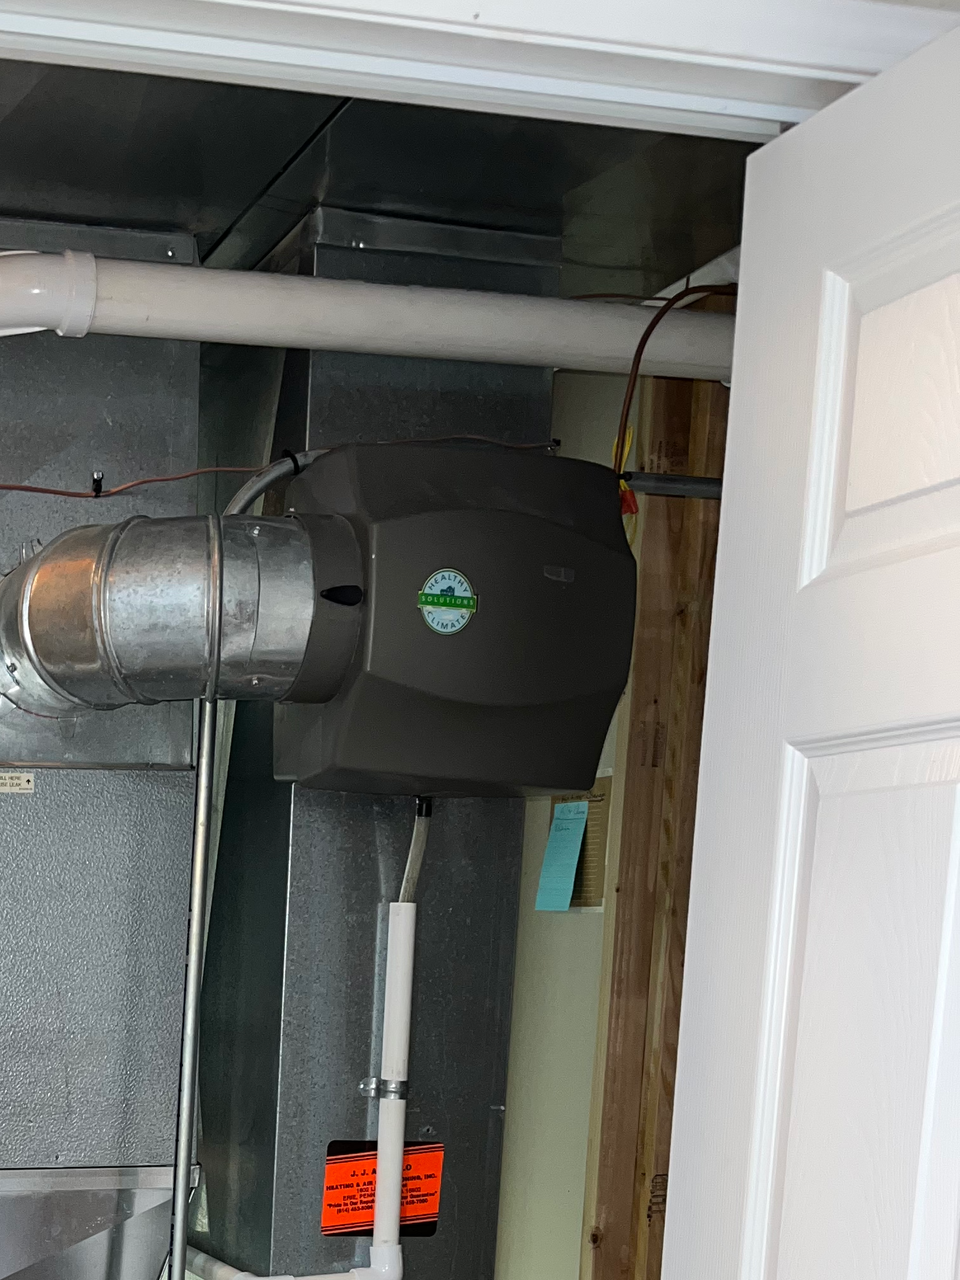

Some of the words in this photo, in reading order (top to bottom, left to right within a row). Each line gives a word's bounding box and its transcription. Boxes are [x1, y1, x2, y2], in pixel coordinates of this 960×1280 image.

[428, 573, 470, 593] HEALTHY
[421, 595, 474, 606] SOLUTIONS
[426, 611, 467, 630] CLIMATE
[350, 1170, 359, 1178] J.
[326, 1182, 354, 1192] HEATING
